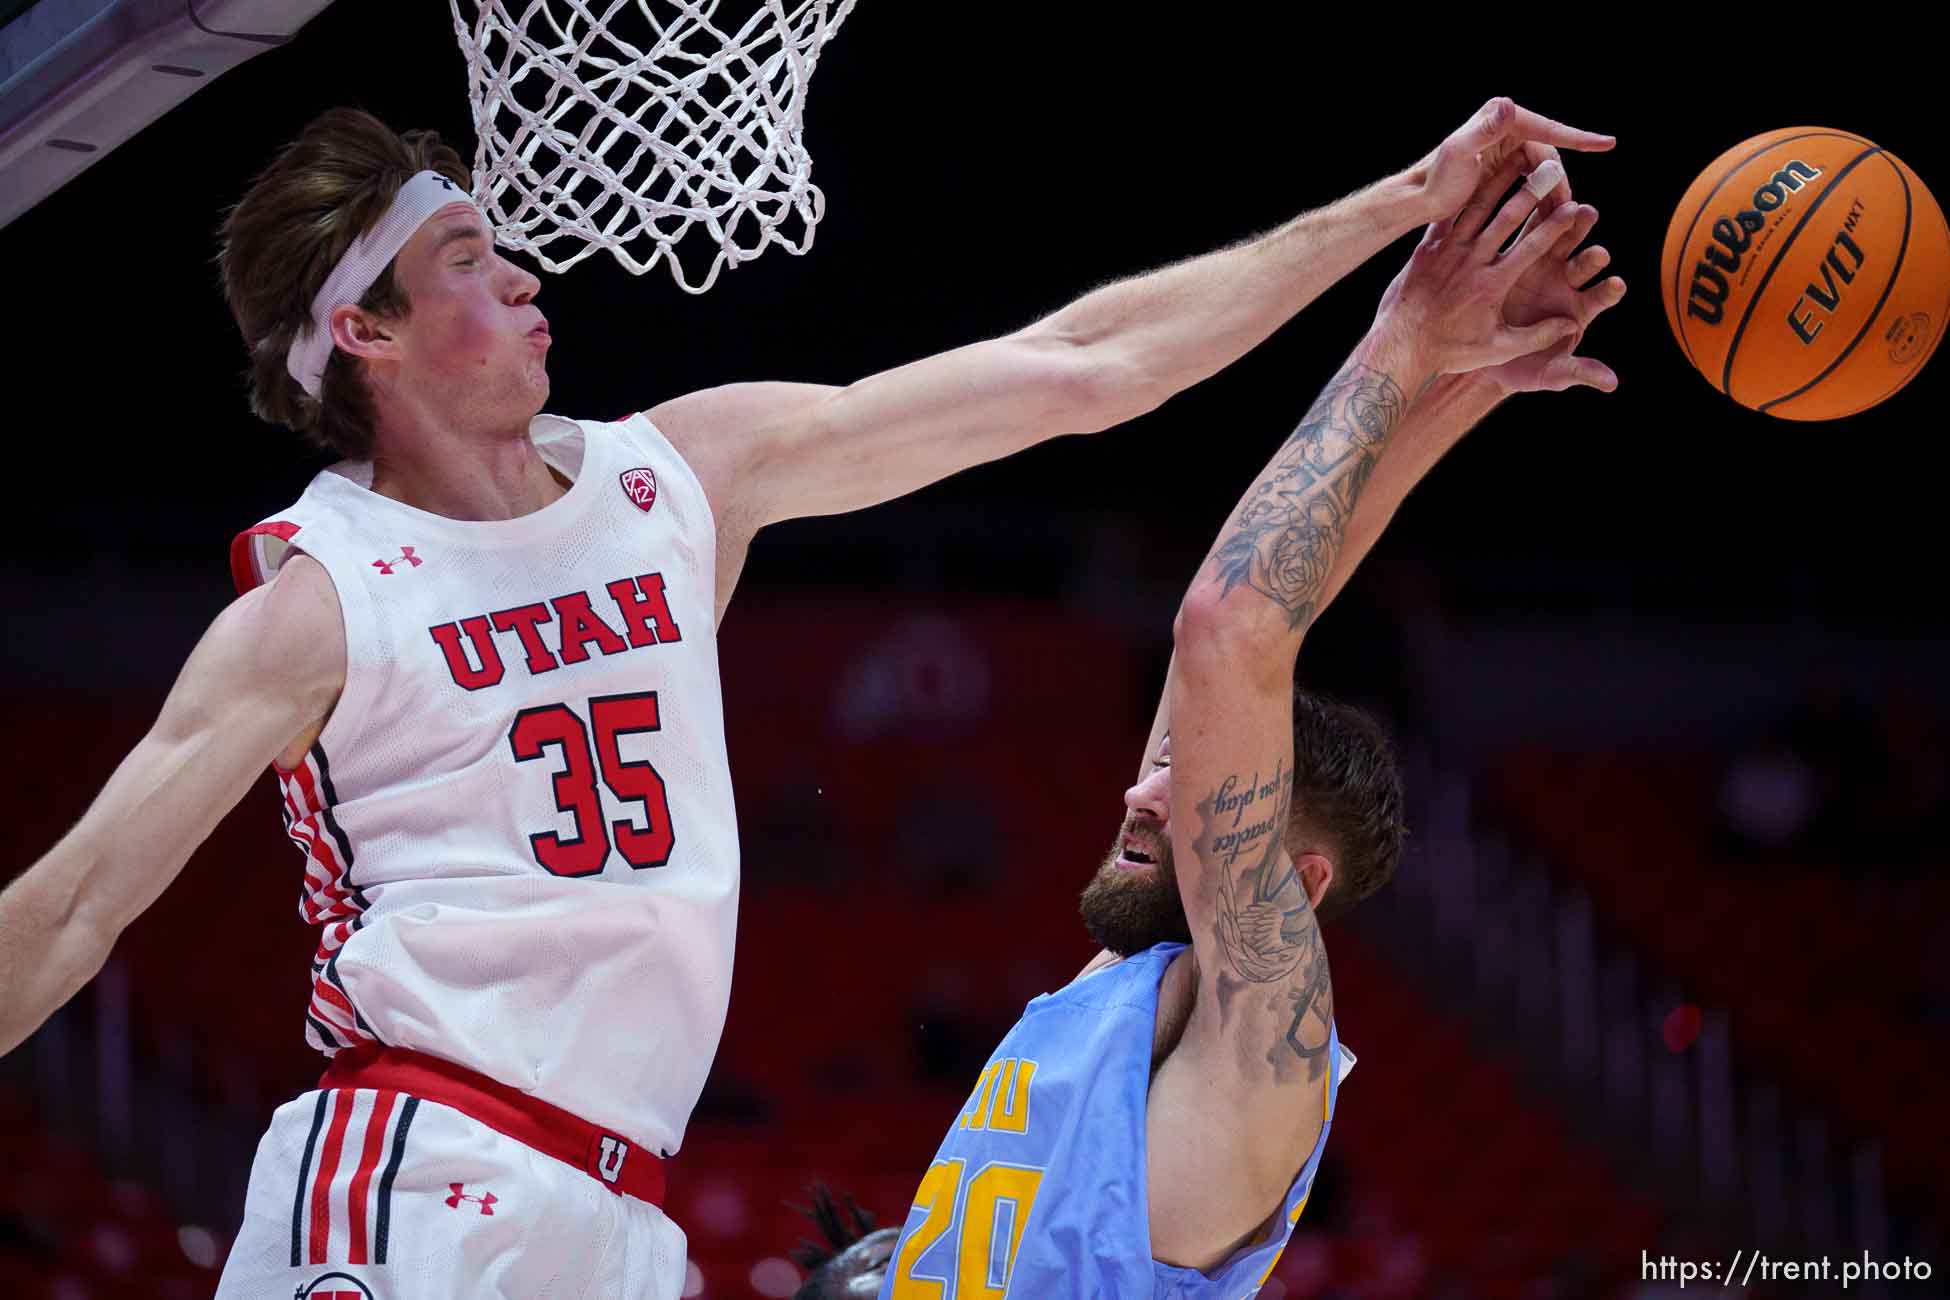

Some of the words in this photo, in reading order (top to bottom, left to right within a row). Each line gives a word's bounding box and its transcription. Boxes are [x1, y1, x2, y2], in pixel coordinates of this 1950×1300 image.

[1687, 159, 1823, 326] Wilson
[1786, 230, 1865, 345] EVO
[1847, 197, 1867, 233] NXT
[622, 468, 655, 497] PAC
[633, 486, 654, 504] 12
[429, 572, 682, 691] UTAH
[508, 690, 676, 878] 35
[1214, 771, 1259, 828] play
[597, 1134, 629, 1185] U
[890, 1156, 1048, 1300] 20
